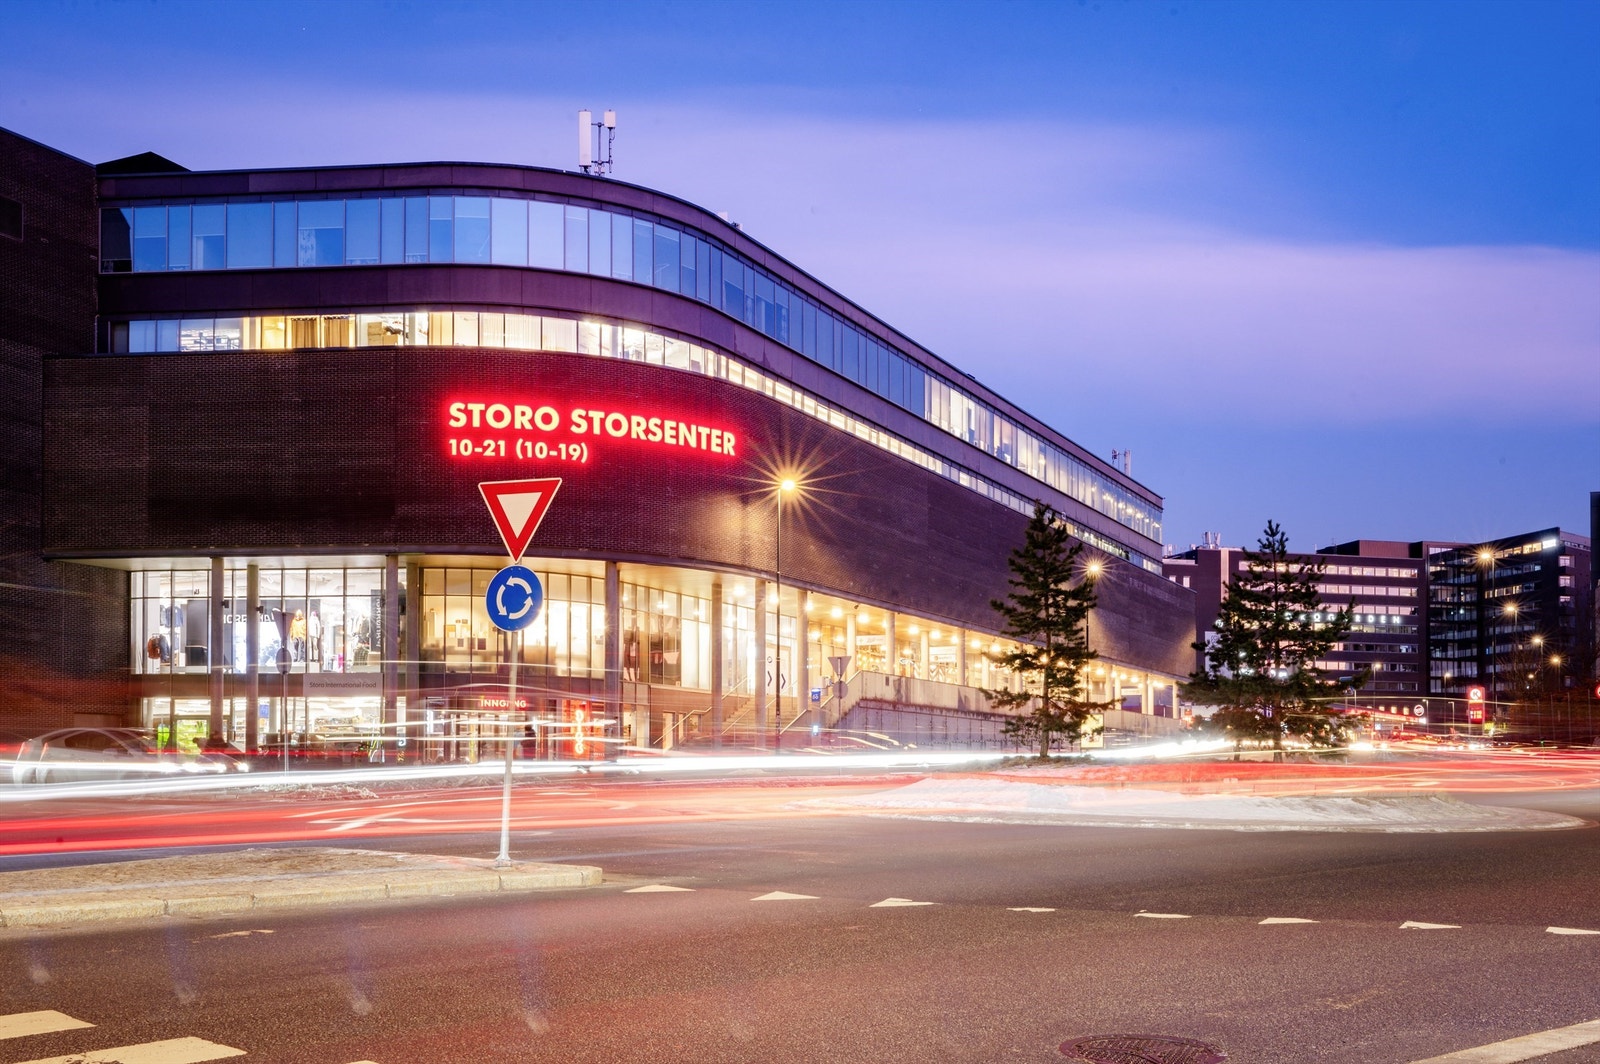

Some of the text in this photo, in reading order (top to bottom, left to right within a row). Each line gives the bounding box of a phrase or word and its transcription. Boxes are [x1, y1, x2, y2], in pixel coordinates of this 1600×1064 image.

[449, 402, 736, 456] STORO STORSENTER
[449, 438, 588, 463] 10-21 (10-19)
[480, 699, 527, 708] INNGNG
